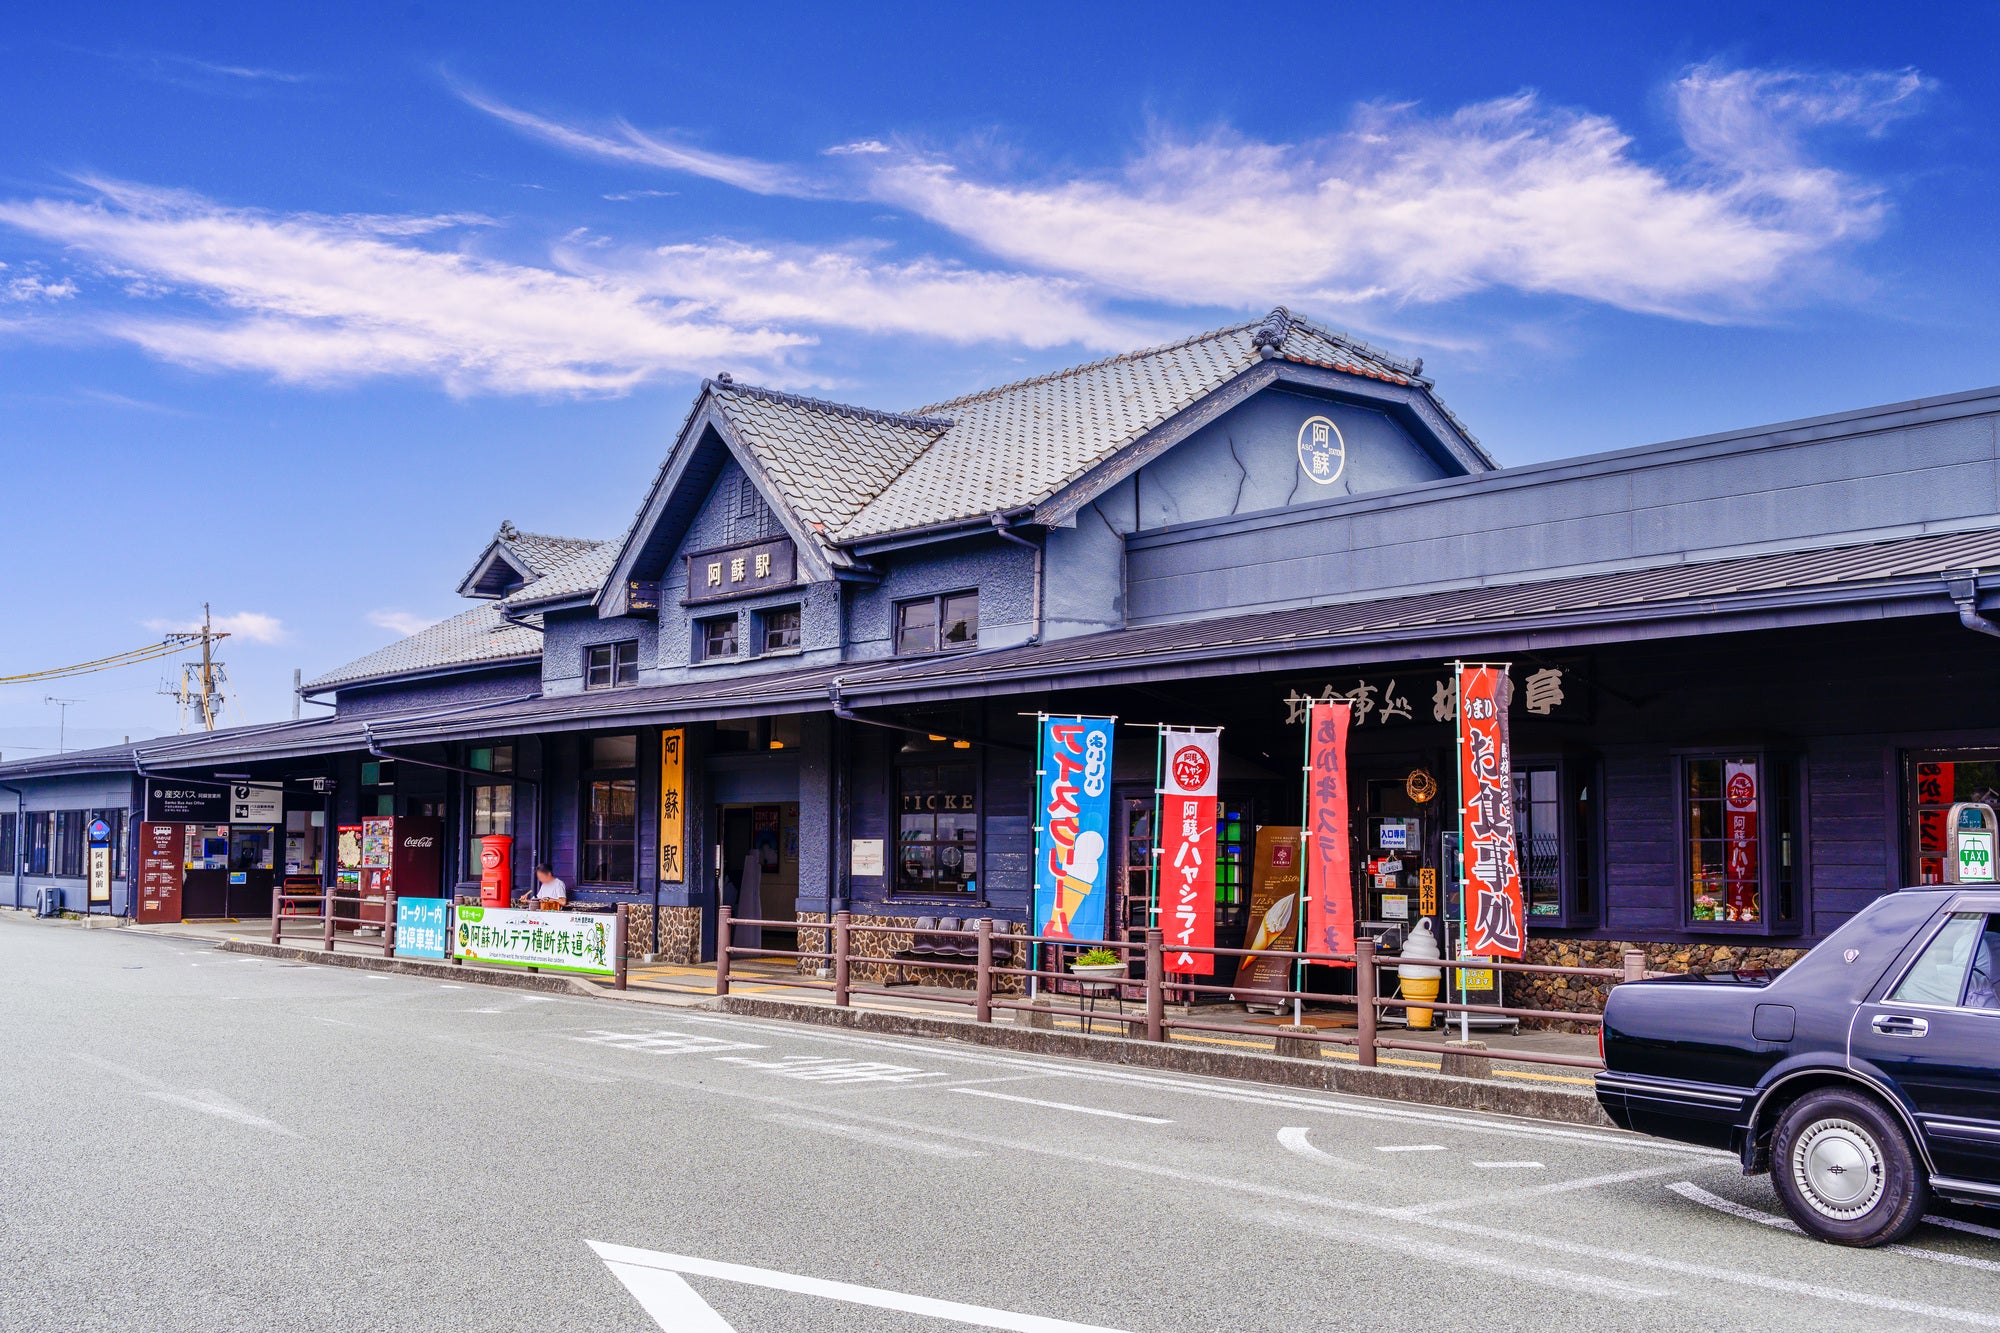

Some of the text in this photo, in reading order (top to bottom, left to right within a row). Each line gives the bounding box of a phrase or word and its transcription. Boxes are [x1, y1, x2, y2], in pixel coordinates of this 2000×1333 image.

[1301, 443, 1313, 452] ASO
[1313, 423, 1330, 476] 阿蘇
[707, 553, 771, 587] 阿蘇駅
[1176, 763, 1203, 776] ハヤシ
[1180, 774, 1201, 786] ライス
[164, 790, 196, 799] 産交バス
[663, 735, 681, 873] 阿蘇駅
[1468, 727, 1521, 951] お食事処
[95, 851, 104, 888] 阿蘇駅前
[1964, 850, 1986, 861] TAXI
[1173, 800, 1203, 965] 阿蘇ハヤシライス
[1421, 869, 1434, 914] 営業中
[401, 904, 443, 924] ロータリー内
[397, 926, 443, 951] 駐停車禁止
[471, 925, 584, 957] 阿蘇カルデラ横断鉄道
